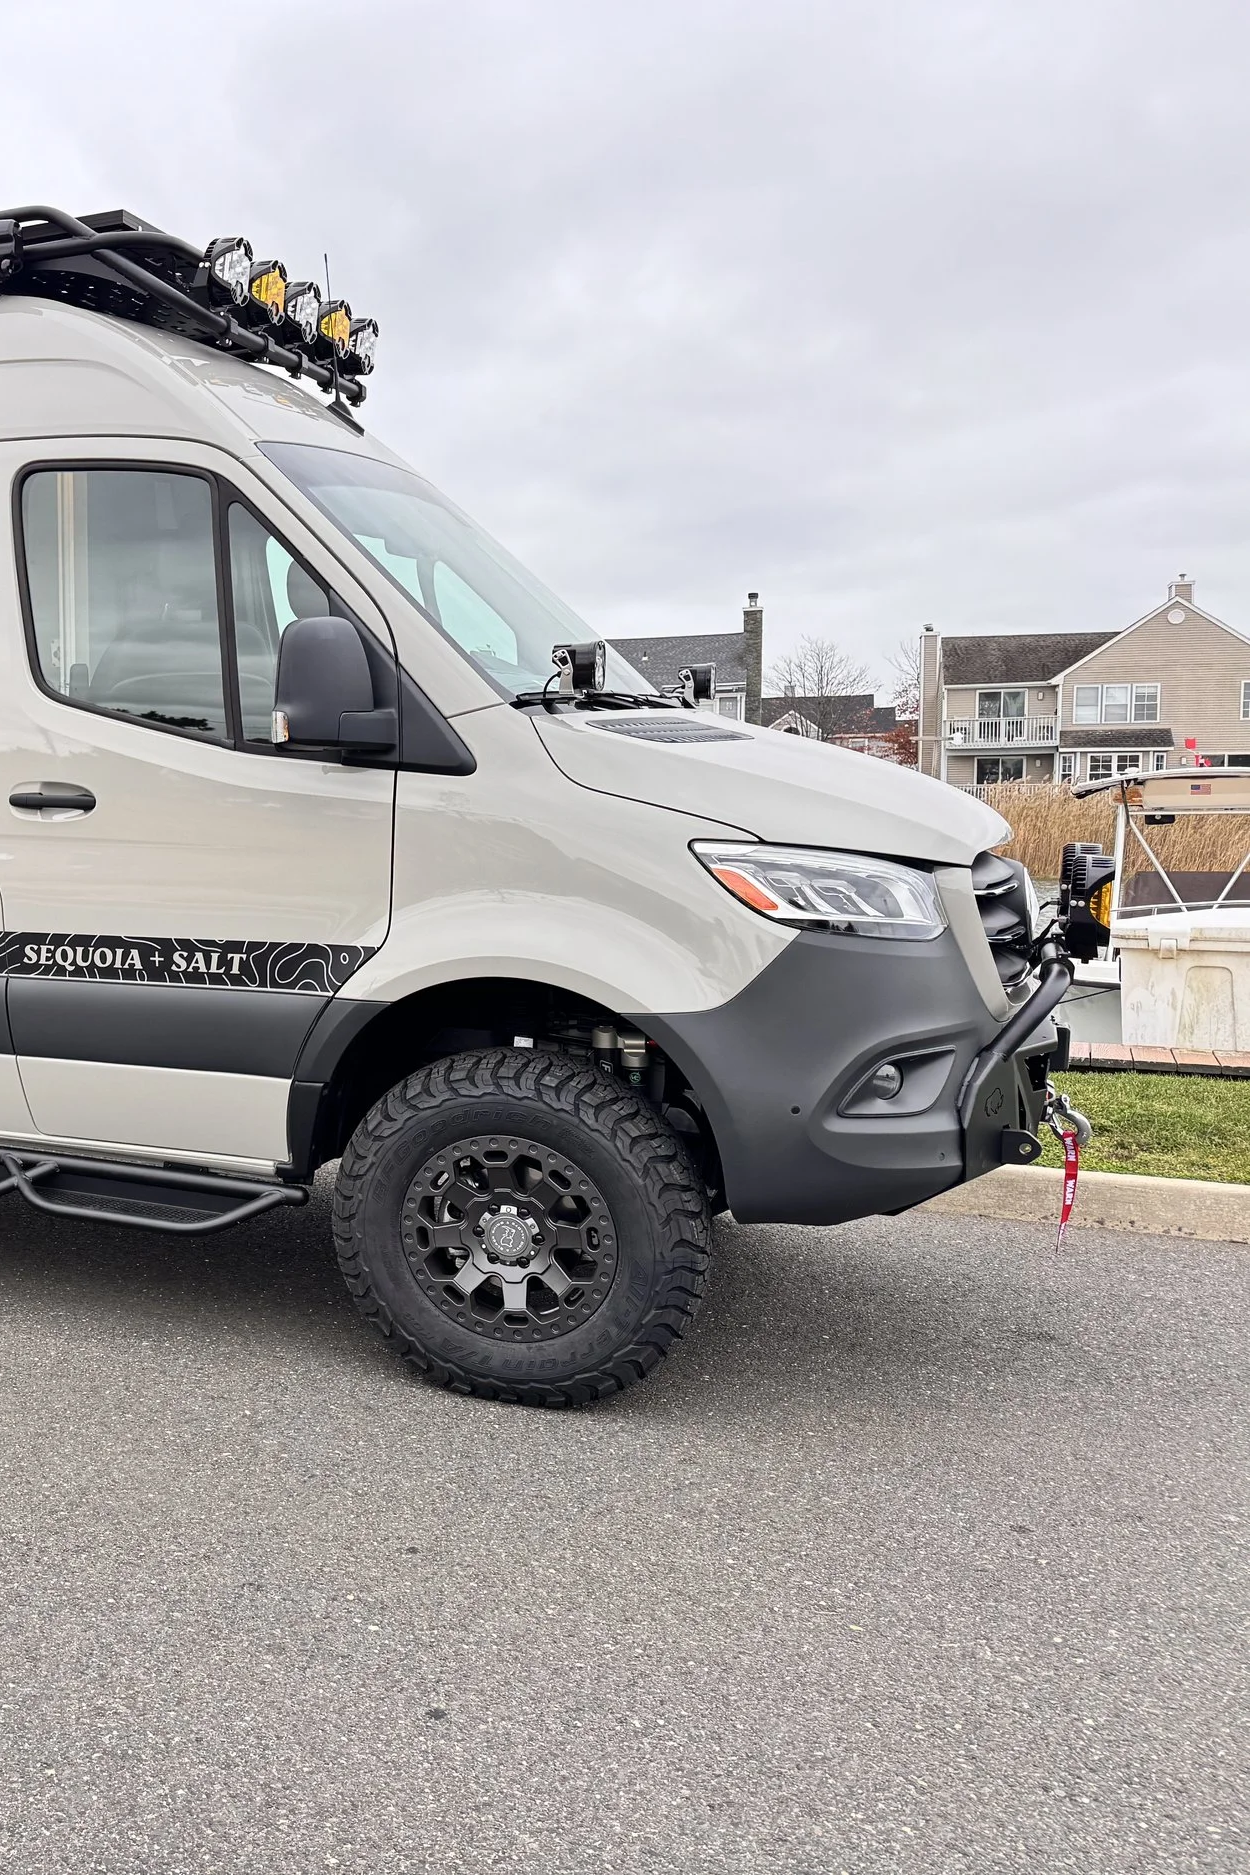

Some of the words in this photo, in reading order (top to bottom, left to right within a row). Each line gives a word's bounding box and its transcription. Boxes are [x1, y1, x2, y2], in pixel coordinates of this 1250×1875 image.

[23, 944, 143, 971] SEQUOIA
[171, 951, 247, 975] SALT
[1064, 1137, 1076, 1161] WARN
[1064, 1179, 1076, 1205] WARN
